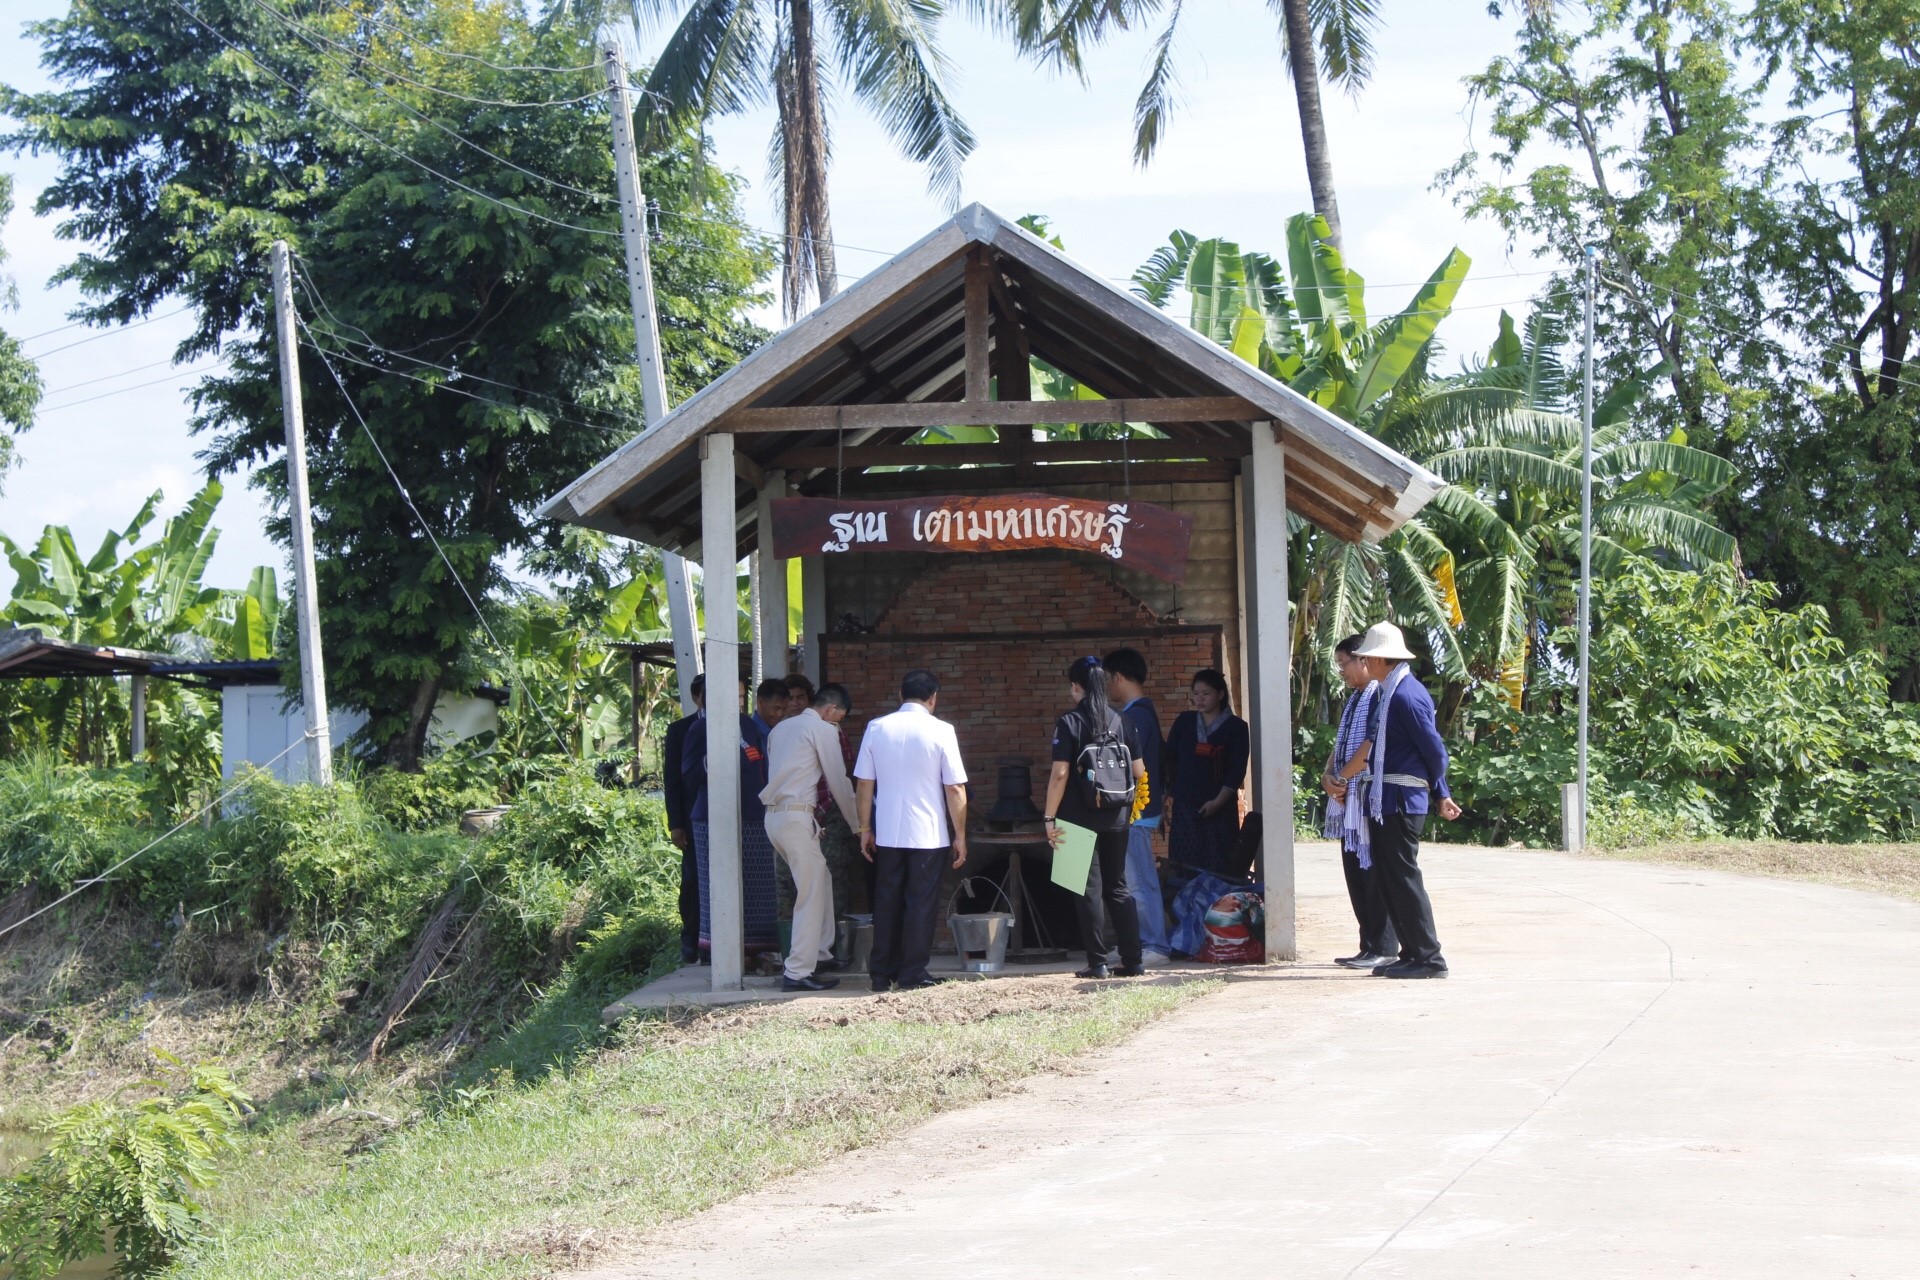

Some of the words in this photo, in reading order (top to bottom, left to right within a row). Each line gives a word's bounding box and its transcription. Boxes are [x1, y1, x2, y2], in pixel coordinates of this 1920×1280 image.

[821, 510, 888, 552] ฐาน
[913, 503, 1131, 559] เตามหาเศรษฐี
